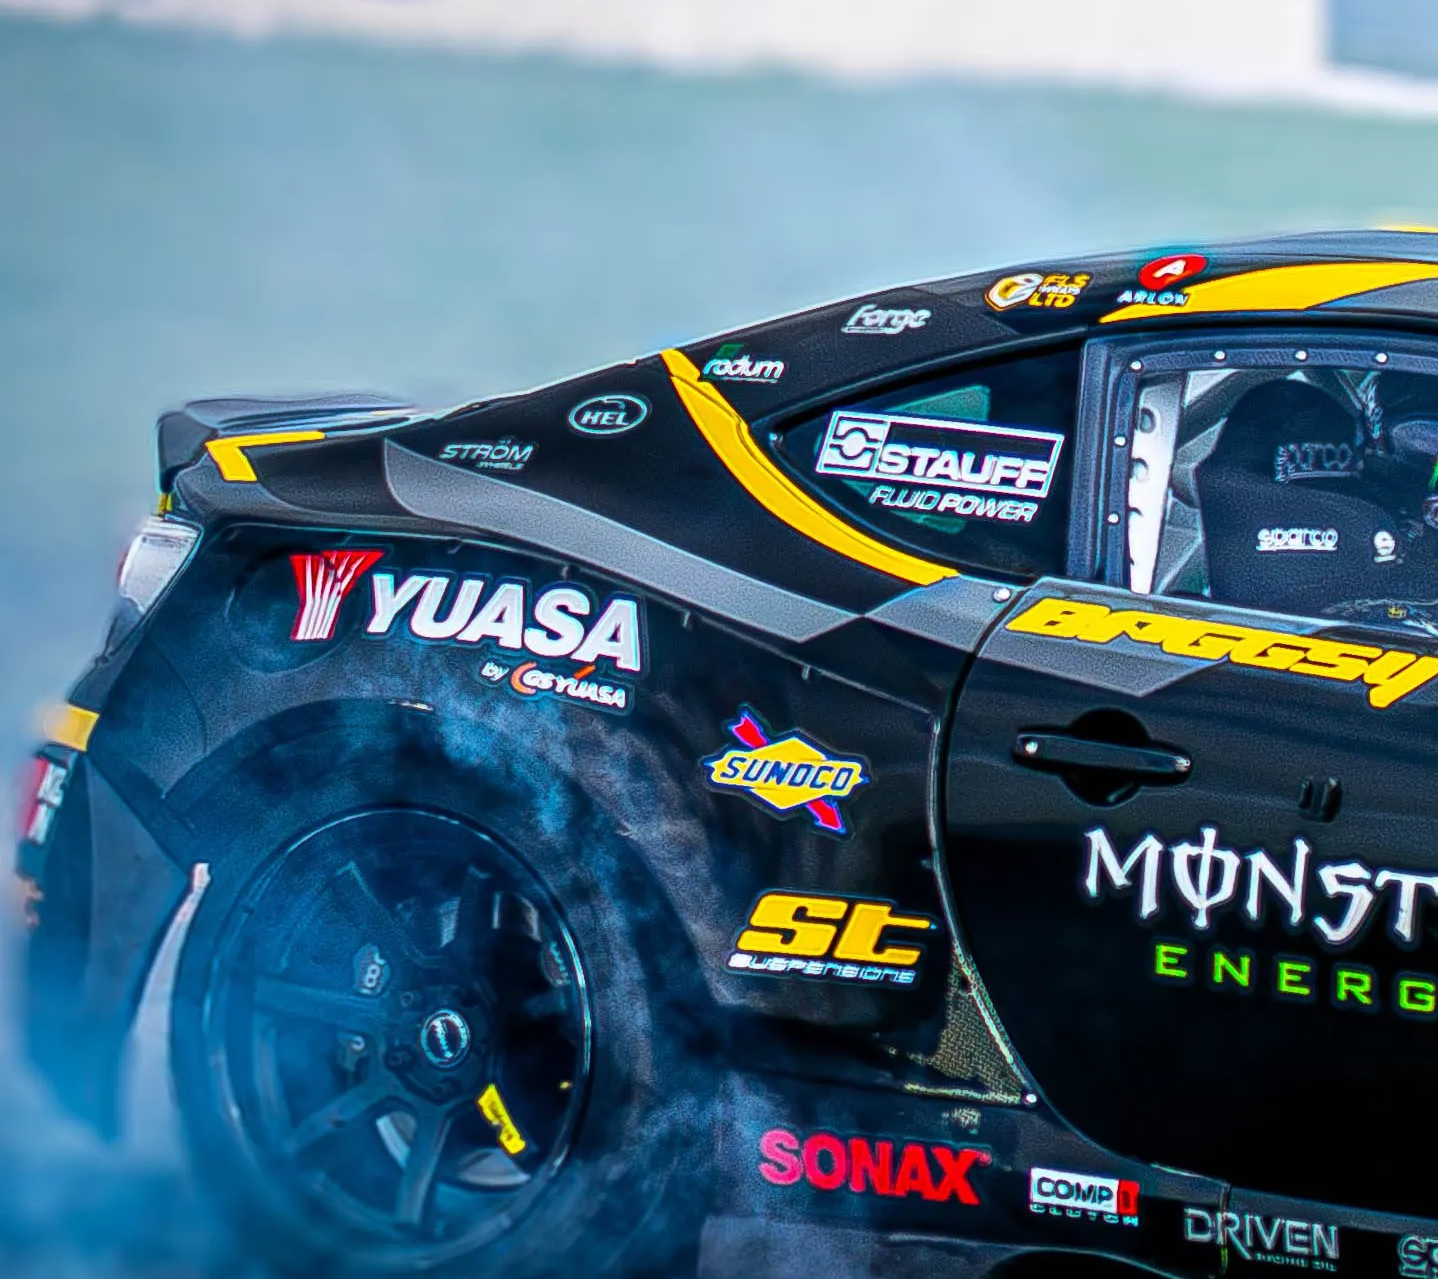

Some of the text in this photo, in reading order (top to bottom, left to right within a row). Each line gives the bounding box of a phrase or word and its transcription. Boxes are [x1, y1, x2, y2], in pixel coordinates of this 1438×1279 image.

[1028, 292, 1075, 308] LTD
[1116, 289, 1189, 306] ARLON
[580, 410, 629, 427] HEL
[439, 439, 533, 462] STRÖM
[877, 443, 1050, 489] STAUFF
[1256, 527, 1339, 551] sparco
[366, 573, 641, 672] YUASA
[481, 661, 509, 681] by
[720, 756, 856, 791] SUNOCO
[758, 1129, 981, 1207] SONAX
[1037, 1177, 1113, 1204] COMP
[1184, 1207, 1339, 1260] DRIVEN
